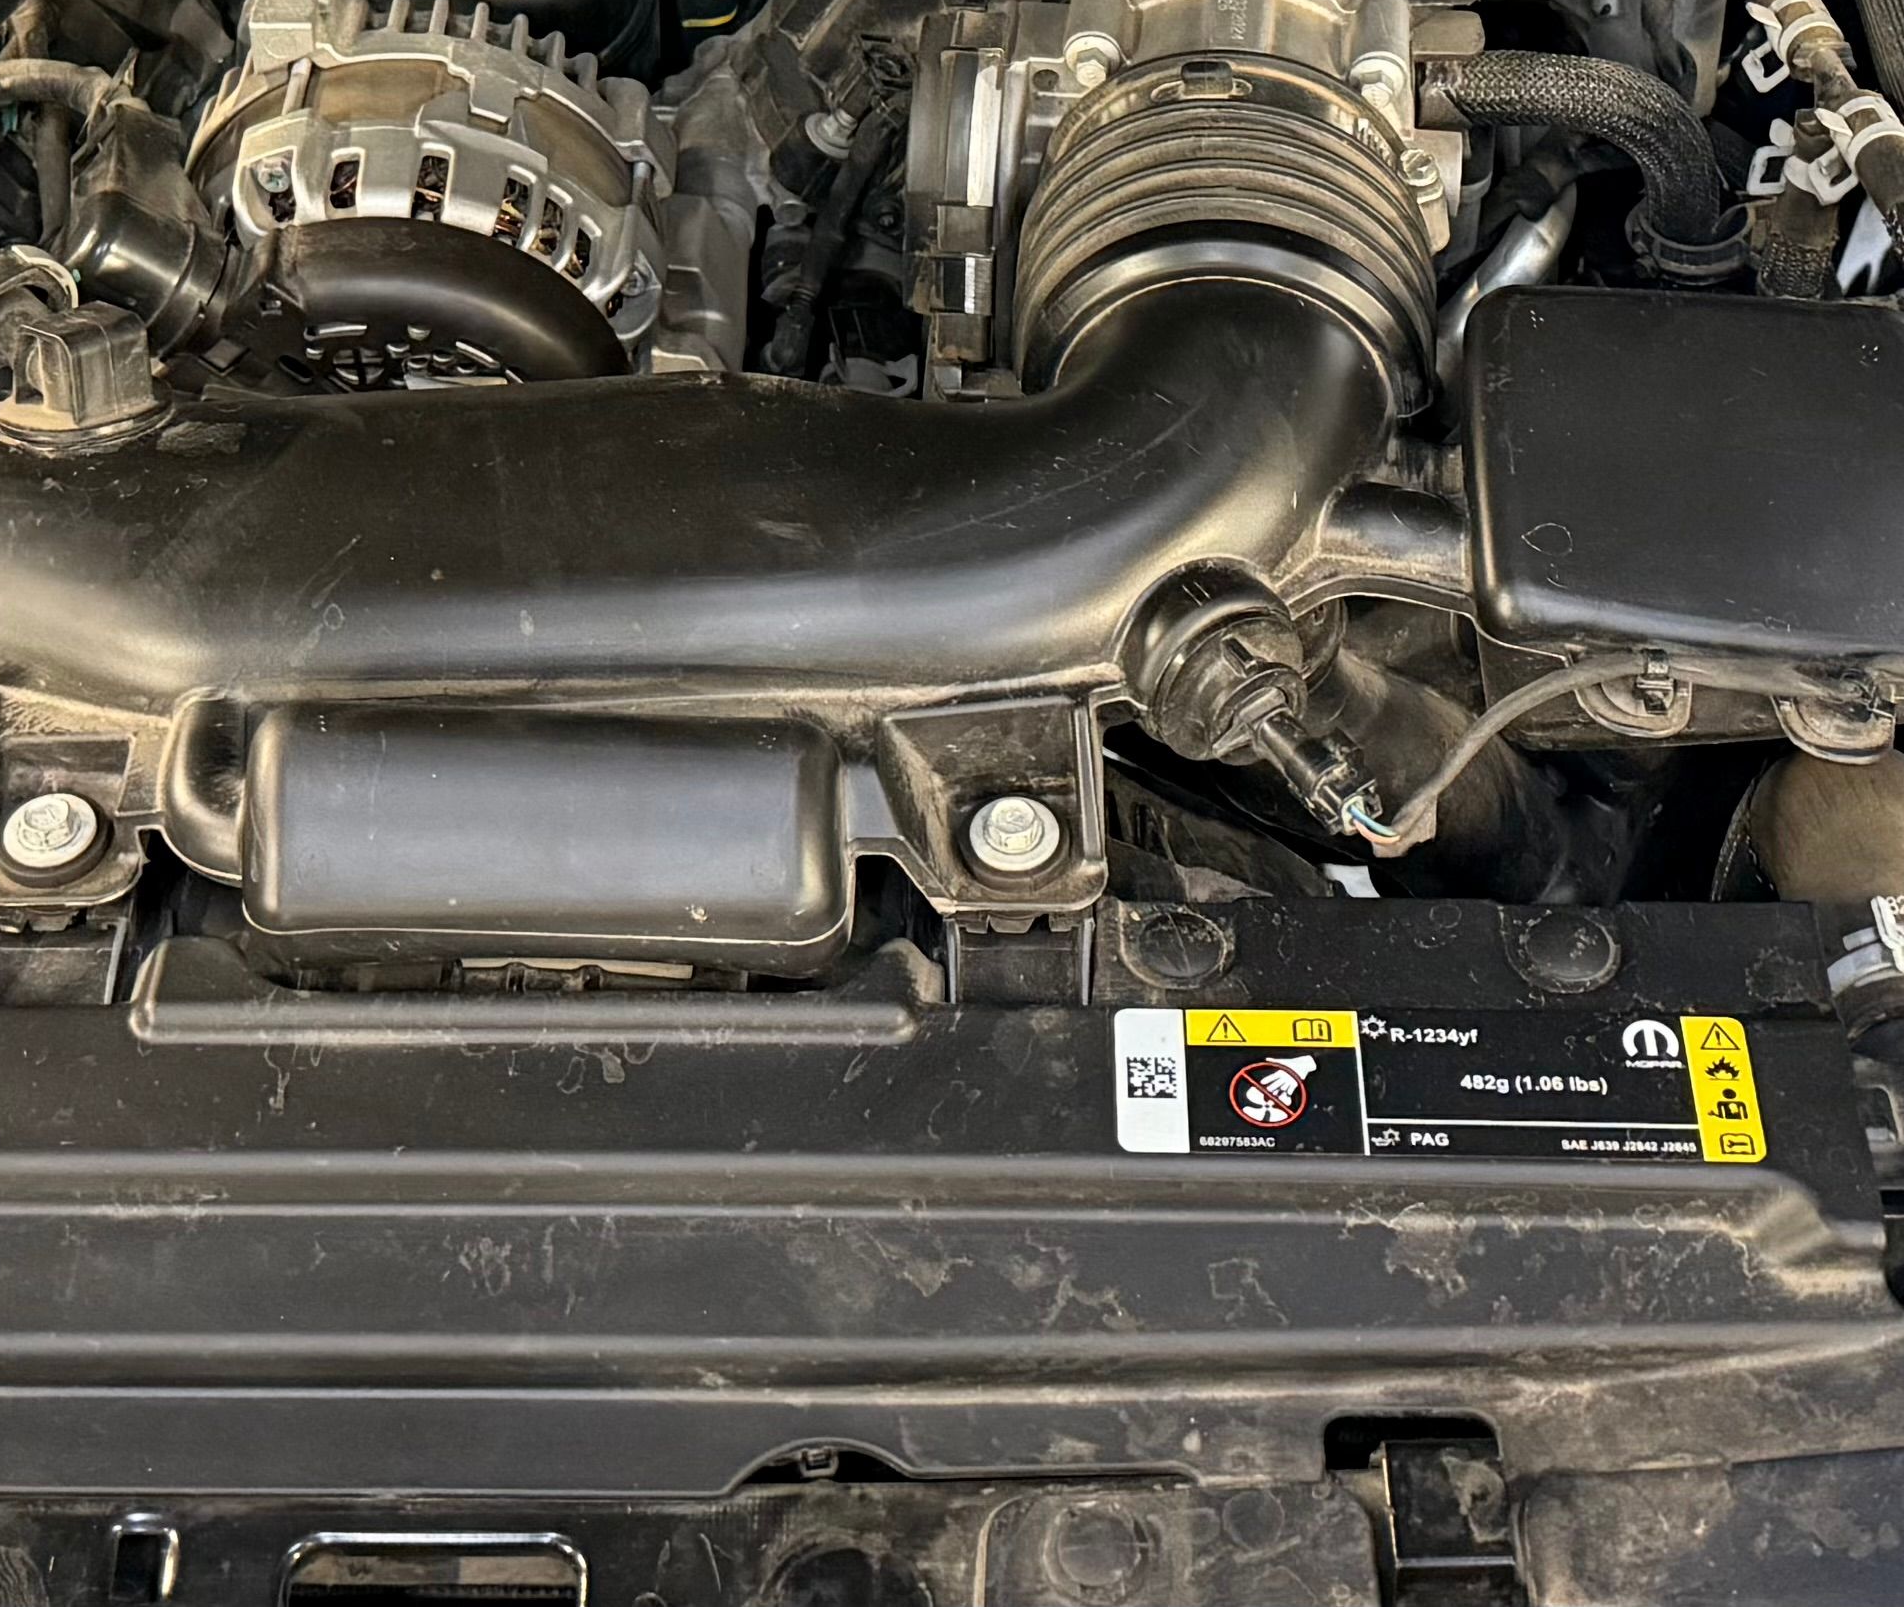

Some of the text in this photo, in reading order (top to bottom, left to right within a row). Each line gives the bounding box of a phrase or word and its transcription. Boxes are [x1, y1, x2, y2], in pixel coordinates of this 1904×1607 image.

[1389, 1027, 1478, 1047] R-1234yf
[1624, 1059, 1686, 1070] MOPAR
[1460, 1074, 1608, 1096] 482g (1.06 lbs)
[1410, 1132, 1450, 1147] PAG
